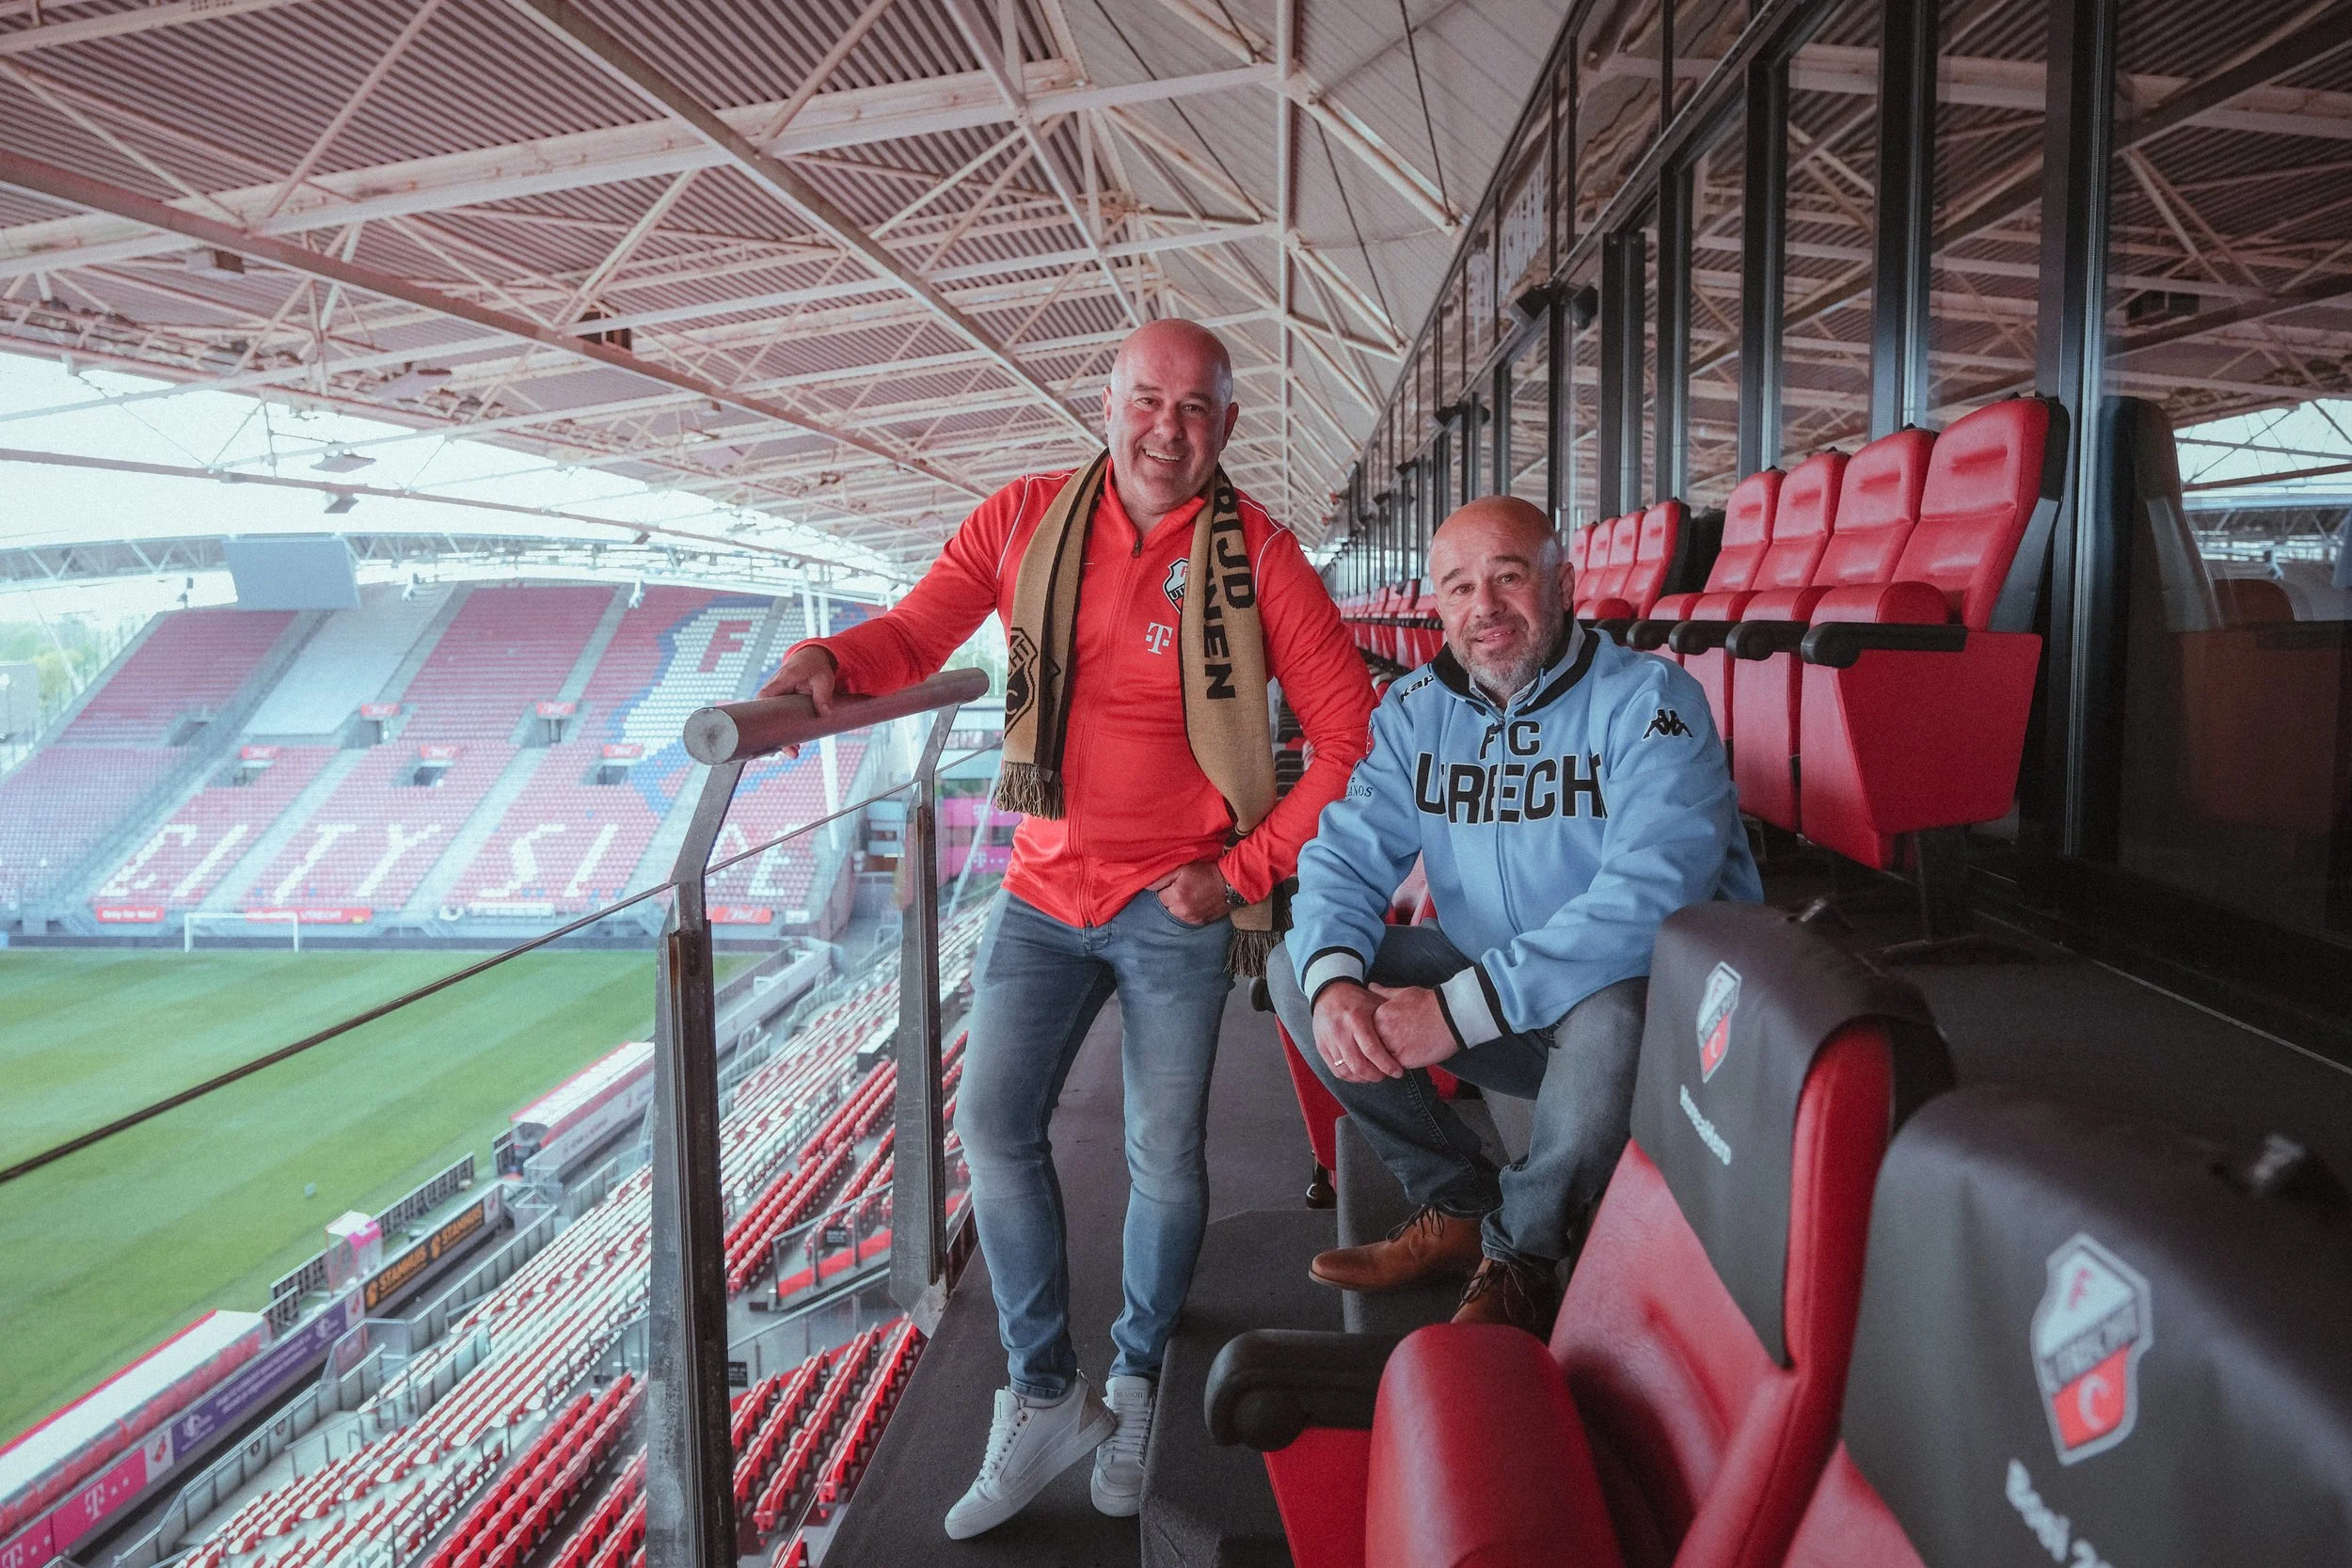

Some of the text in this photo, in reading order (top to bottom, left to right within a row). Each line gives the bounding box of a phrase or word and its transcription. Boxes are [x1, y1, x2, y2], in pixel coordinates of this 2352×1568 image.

[697, 620, 753, 673] F
[1146, 622, 1173, 655] T
[1399, 674, 1435, 704] Kap
[1478, 720, 1541, 761] FC
[2077, 1372, 2112, 1432] C
